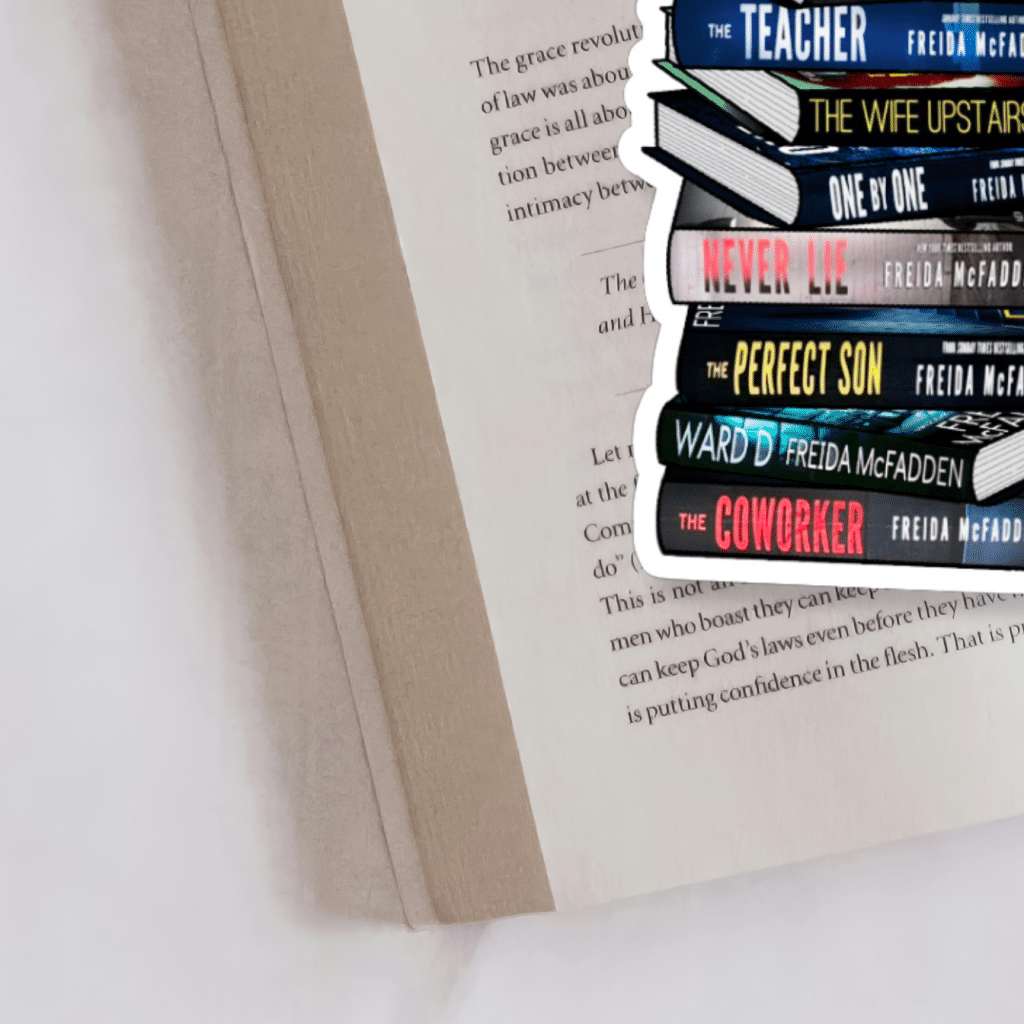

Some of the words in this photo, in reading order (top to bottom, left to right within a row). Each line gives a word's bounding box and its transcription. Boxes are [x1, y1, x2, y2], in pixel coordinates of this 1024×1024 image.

[708, 23, 733, 39] THE
[739, 3, 867, 63] TEACHER
[908, 29, 967, 57] FREIDA
[809, 98, 853, 133] THE
[862, 99, 919, 133] WIFE
[829, 172, 868, 221] ONE
[869, 177, 888, 212] BY
[891, 166, 928, 214] ONE
[971, 174, 1016, 203] FREIDA
[703, 238, 790, 294] NEVER
[807, 238, 849, 295] LIE
[884, 260, 943, 288] FREIDA
[706, 361, 729, 379] THE
[733, 340, 831, 396] PERFECT
[837, 340, 883, 396] SON
[915, 364, 974, 396] FREIDA
[675, 418, 748, 464] WARD
[754, 429, 773, 467] D
[785, 437, 851, 474] FREIDA
[856, 446, 965, 489] McFADDEN
[679, 513, 707, 532] THE
[714, 495, 865, 555] COWORKER
[892, 515, 949, 541] FREIDA
[627, 706, 642, 724] is
[646, 692, 718, 725] putting
[720, 669, 822, 703] confidence
[825, 660, 845, 680] in
[850, 653, 881, 674] the
[884, 641, 934, 667] flesh.
[936, 631, 984, 654] That
[989, 624, 1004, 642] is
